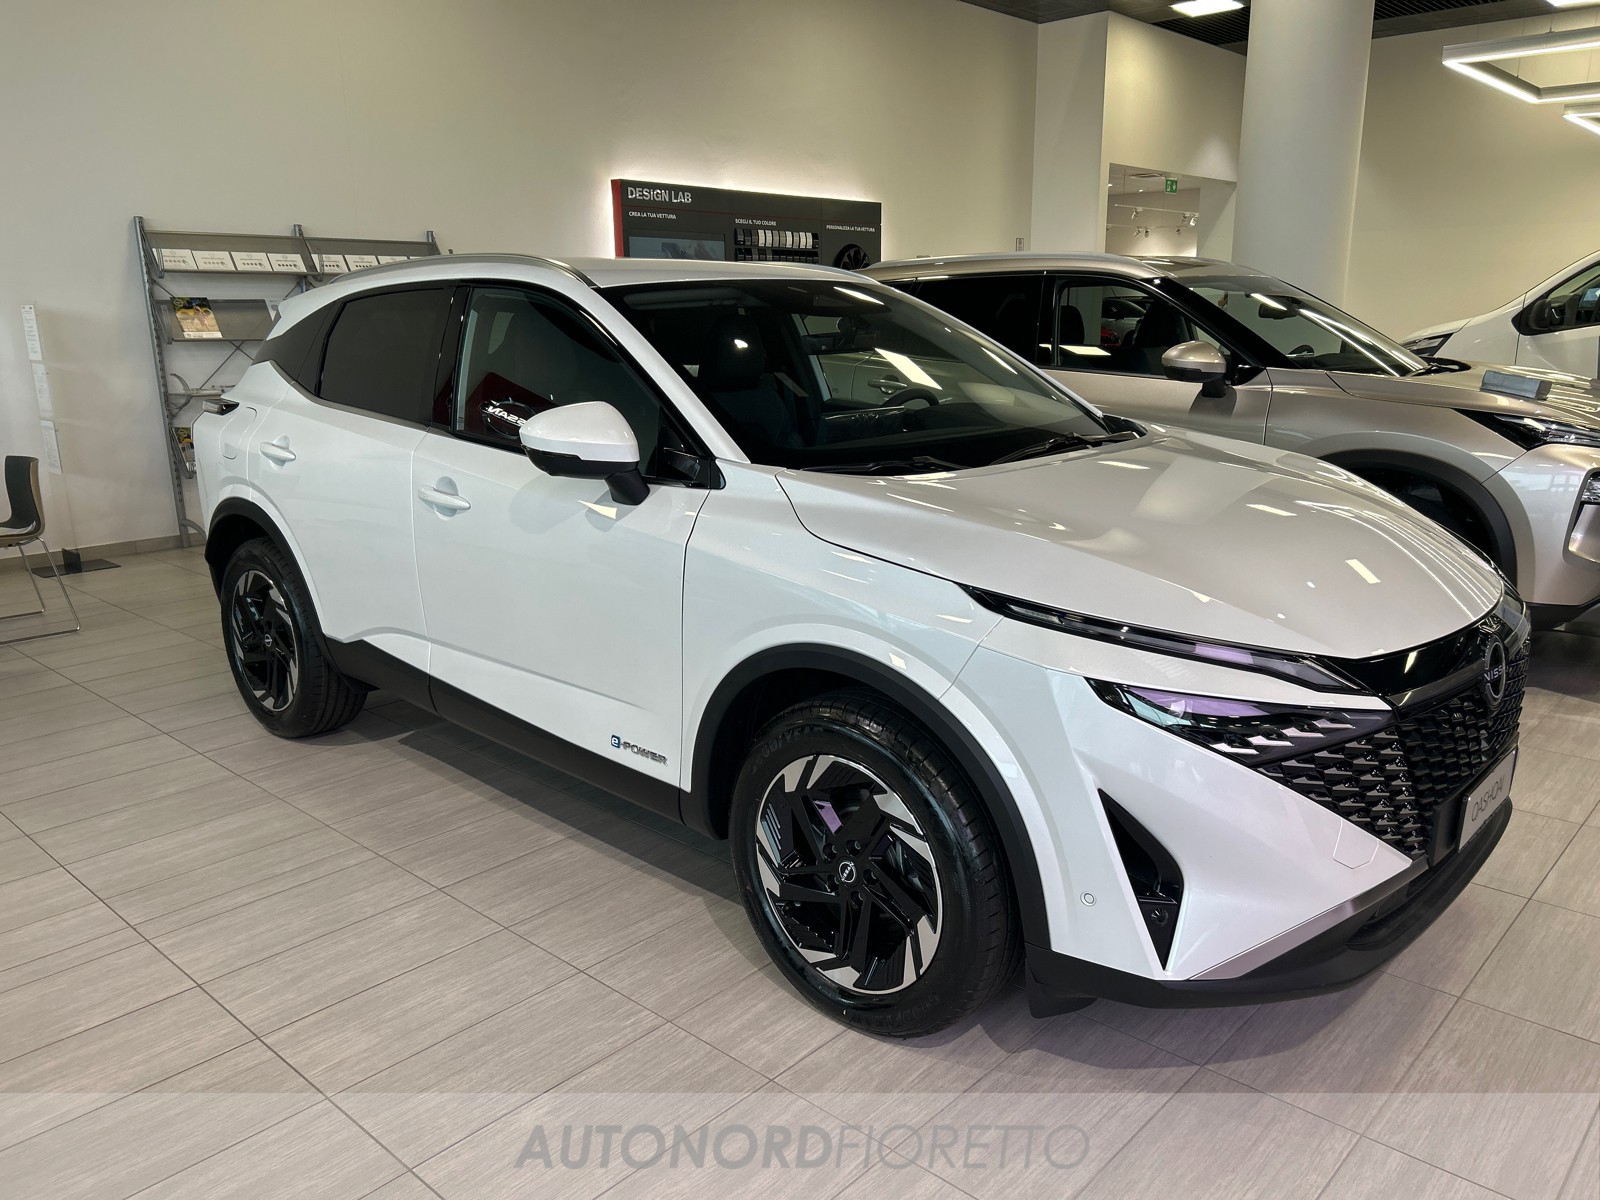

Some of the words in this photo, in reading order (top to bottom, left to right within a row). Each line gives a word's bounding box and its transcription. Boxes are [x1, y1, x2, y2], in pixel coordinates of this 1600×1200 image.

[627, 186, 669, 201] DESIGN
[671, 190, 692, 204] LAB
[1484, 664, 1507, 681] NISS
